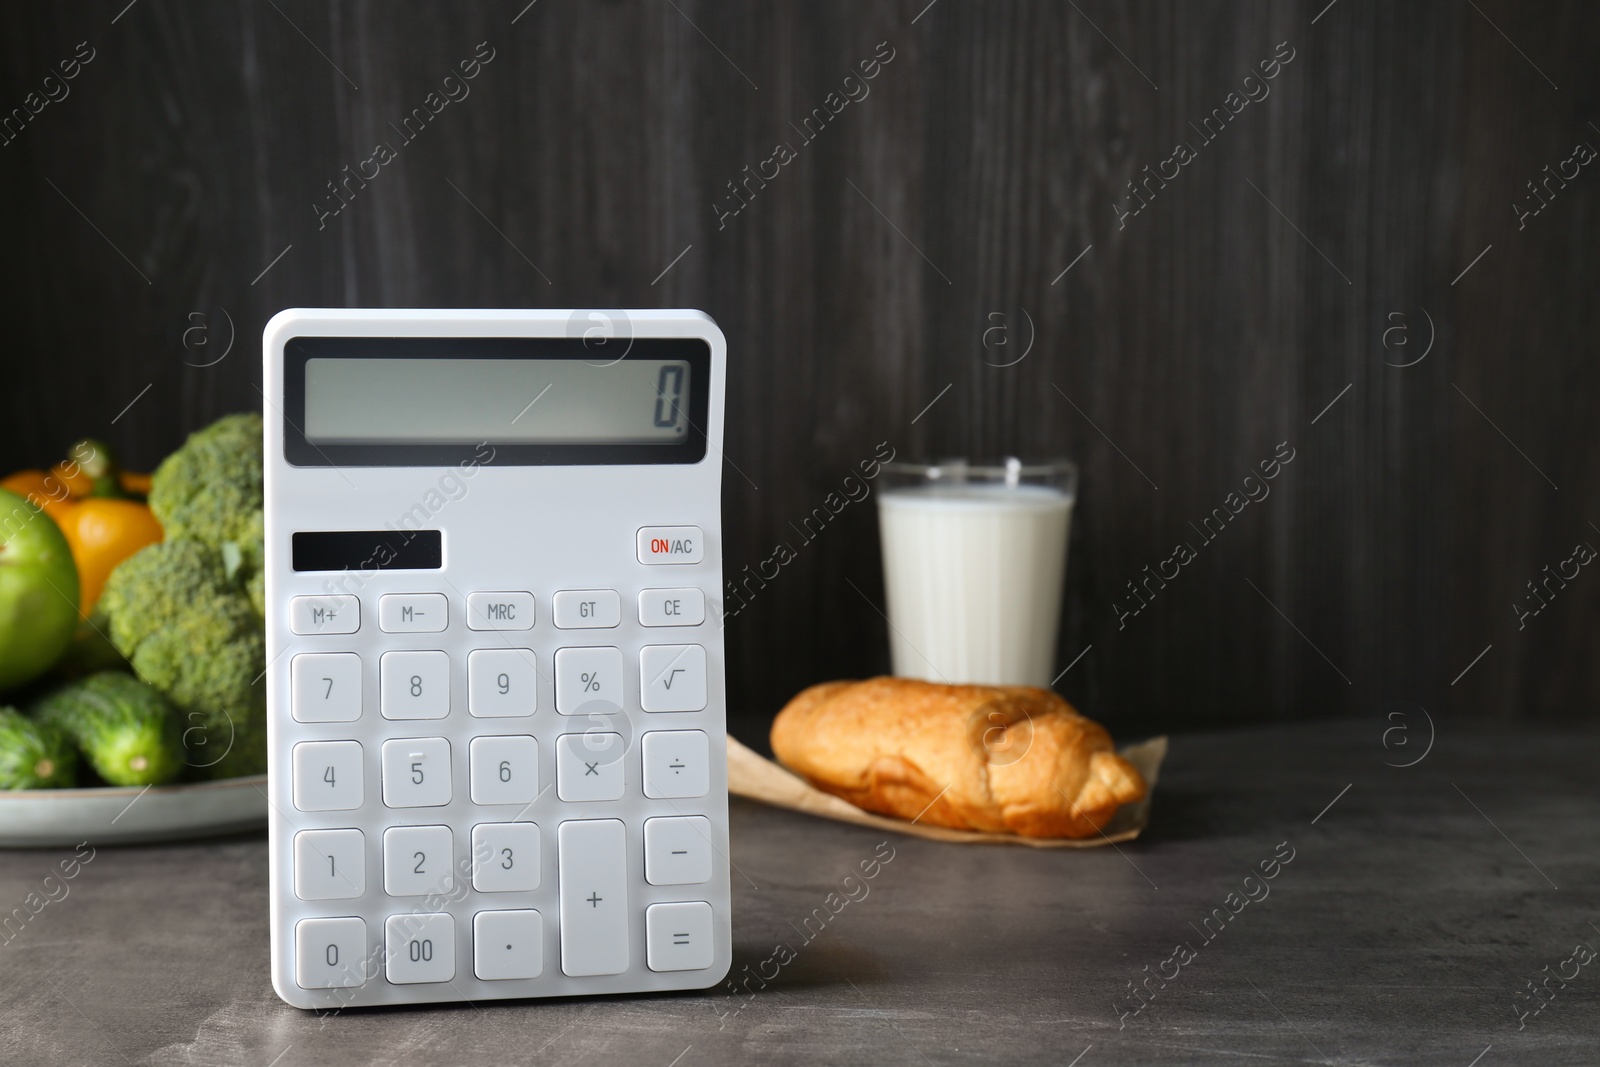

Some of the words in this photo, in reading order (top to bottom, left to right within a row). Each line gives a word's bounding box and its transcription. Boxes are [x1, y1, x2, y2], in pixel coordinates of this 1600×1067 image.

[651, 538, 692, 554] ON/AC
[313, 608, 337, 624] M+
[402, 605, 425, 622] M-
[487, 603, 516, 620] MRC
[579, 601, 596, 618] GT
[664, 599, 681, 616] CE
[322, 677, 334, 699] 7
[410, 675, 423, 697] 8
[497, 673, 510, 695] 9
[580, 671, 600, 693] %
[323, 766, 336, 788] 4
[411, 763, 424, 785] 5
[499, 761, 512, 782] 6
[327, 855, 335, 877] 1
[413, 852, 426, 874] 2
[501, 848, 514, 870] 3
[326, 944, 339, 966] 0
[409, 940, 433, 962] 00
